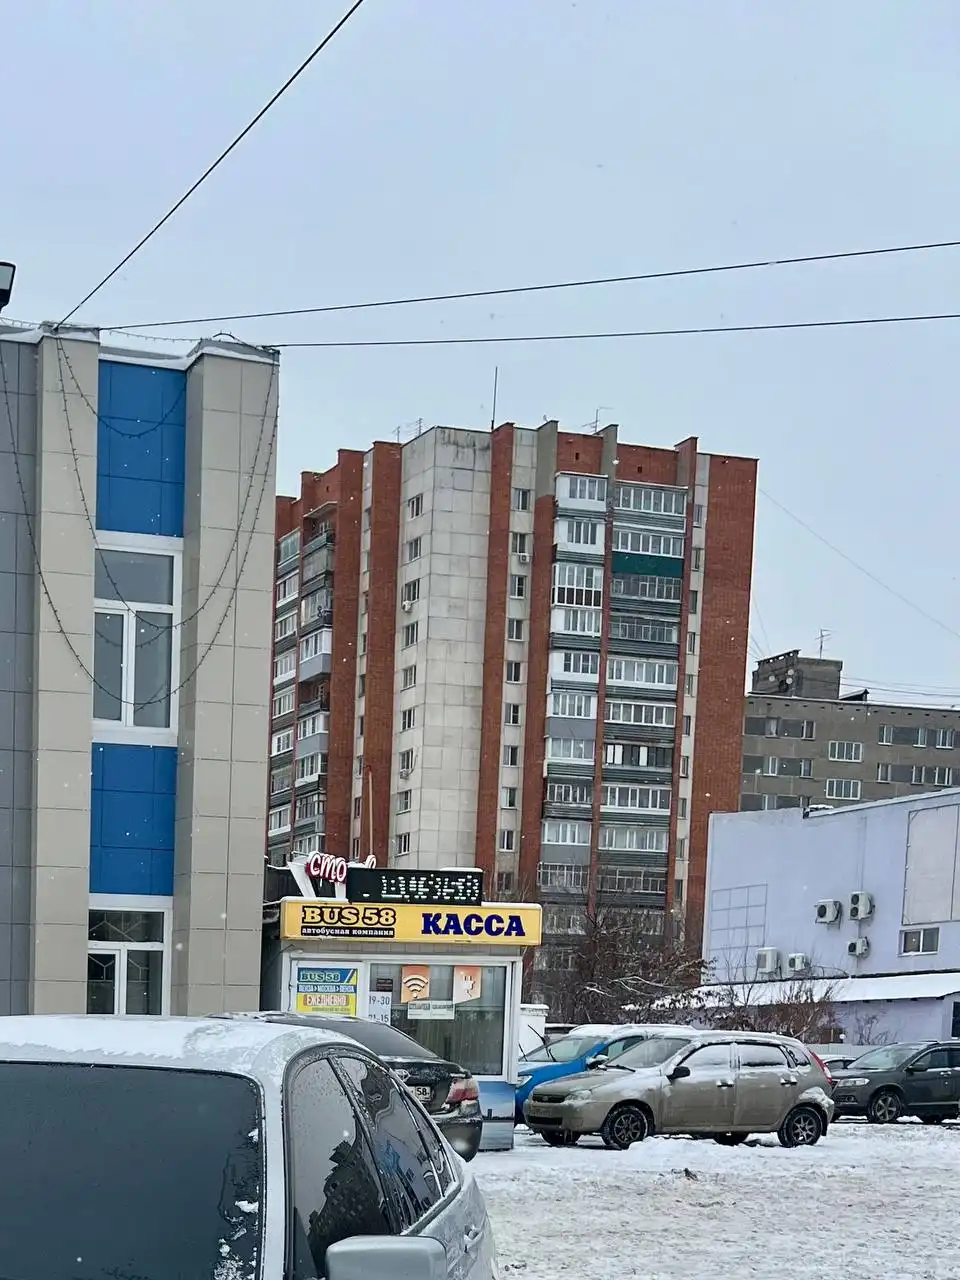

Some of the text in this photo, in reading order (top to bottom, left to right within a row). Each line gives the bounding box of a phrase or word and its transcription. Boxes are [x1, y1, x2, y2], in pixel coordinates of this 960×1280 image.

[302, 907, 396, 926] BUS 58
[302, 927, 394, 936] автобусная компания
[421, 913, 525, 936] КАССА
[300, 971, 341, 982] BUS 58
